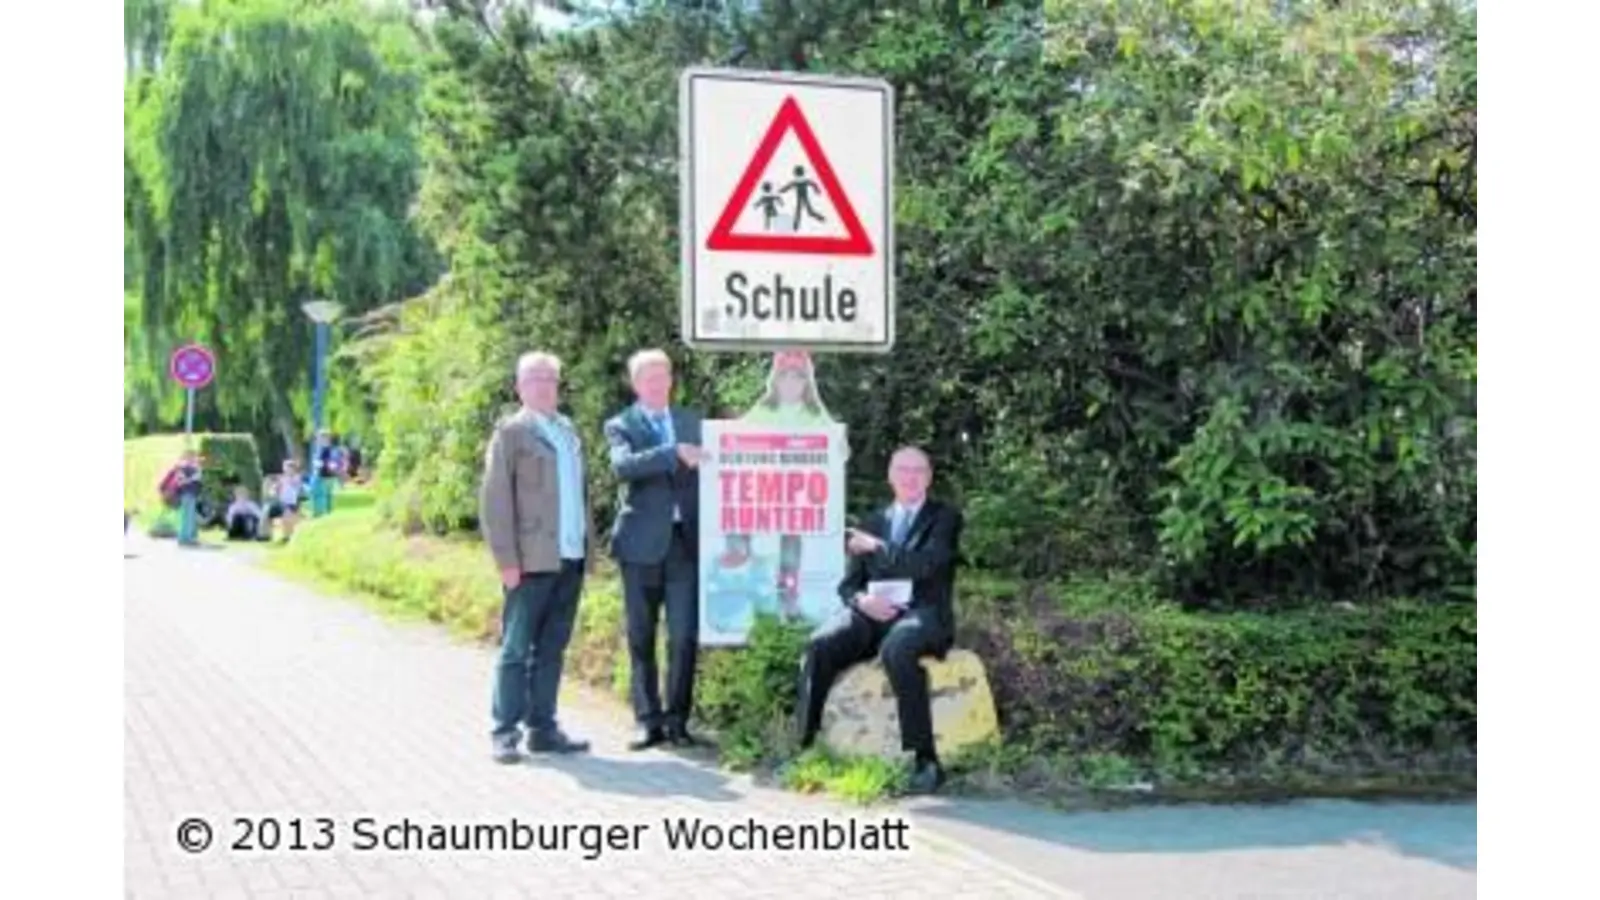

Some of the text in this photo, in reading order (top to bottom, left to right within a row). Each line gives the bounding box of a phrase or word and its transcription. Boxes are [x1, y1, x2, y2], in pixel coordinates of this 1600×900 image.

[724, 270, 858, 323] Schule
[718, 470, 829, 505] TEMPO
[719, 506, 826, 532] RUNTER!
